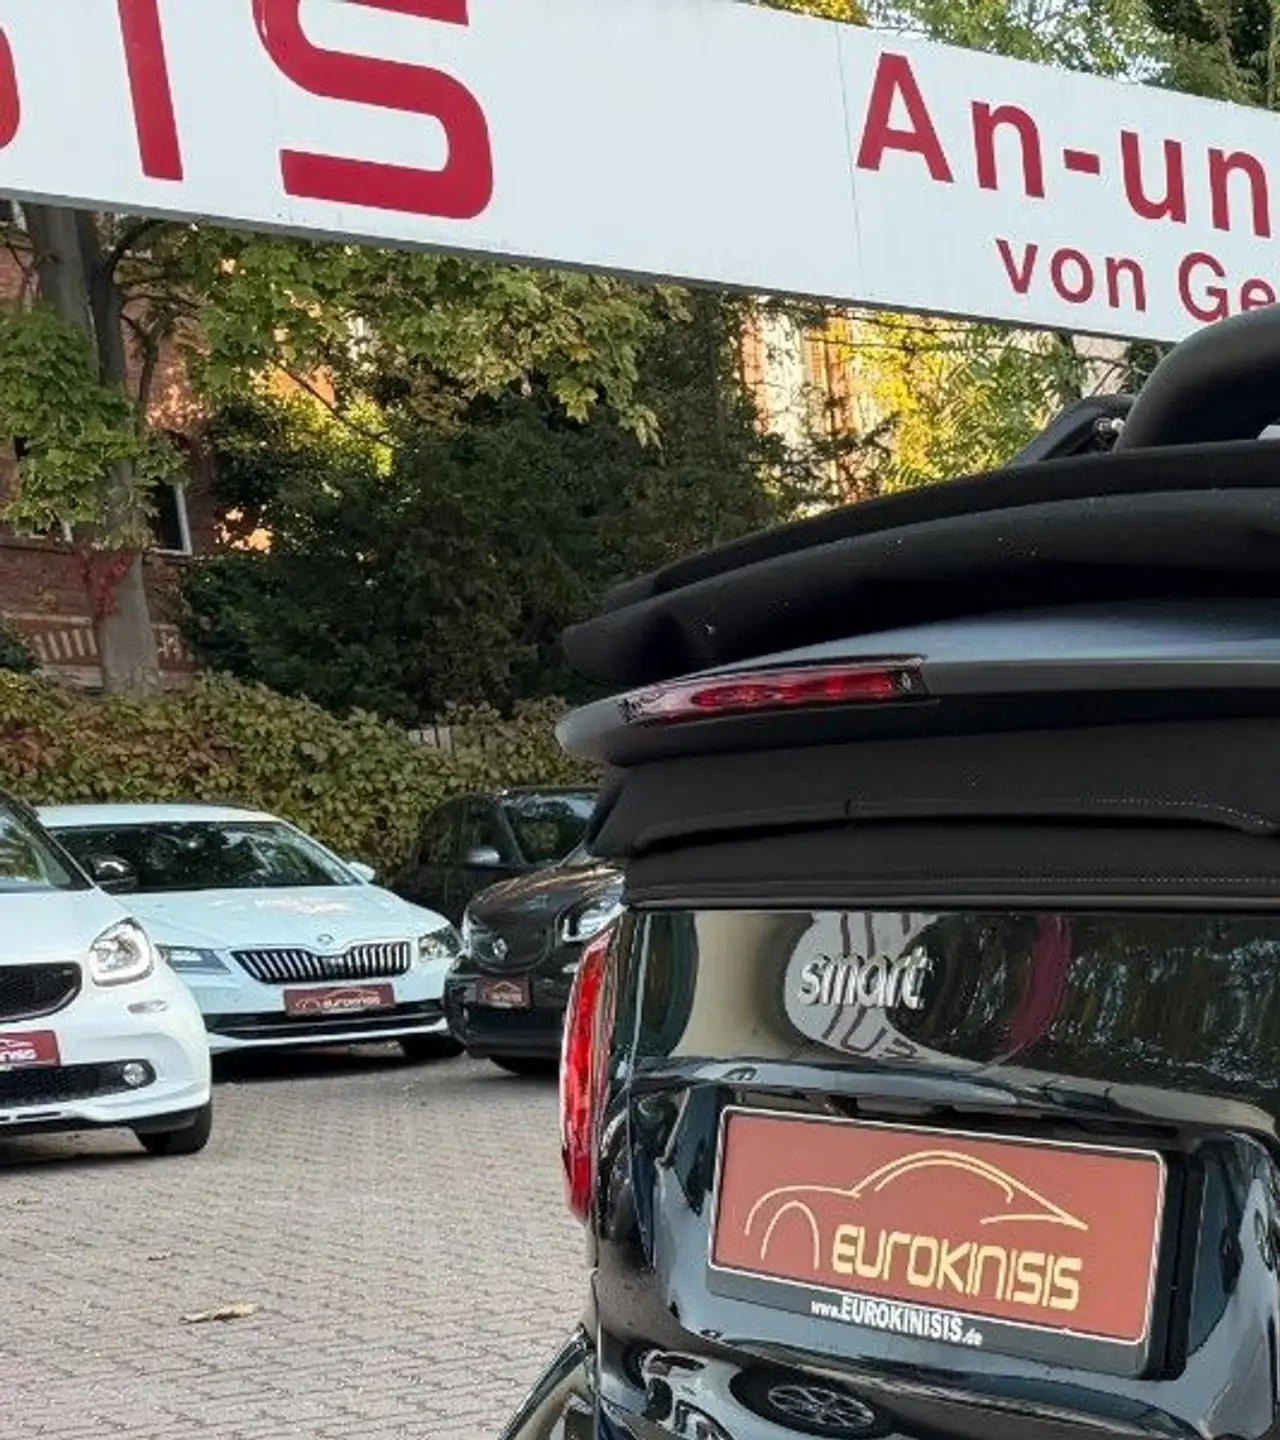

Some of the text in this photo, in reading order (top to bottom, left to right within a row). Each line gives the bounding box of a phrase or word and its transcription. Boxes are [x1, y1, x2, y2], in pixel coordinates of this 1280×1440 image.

[995, 238, 1147, 312] von
[797, 946, 928, 1011] smart
[811, 1296, 983, 1349] www.EUROKINISIS.de
